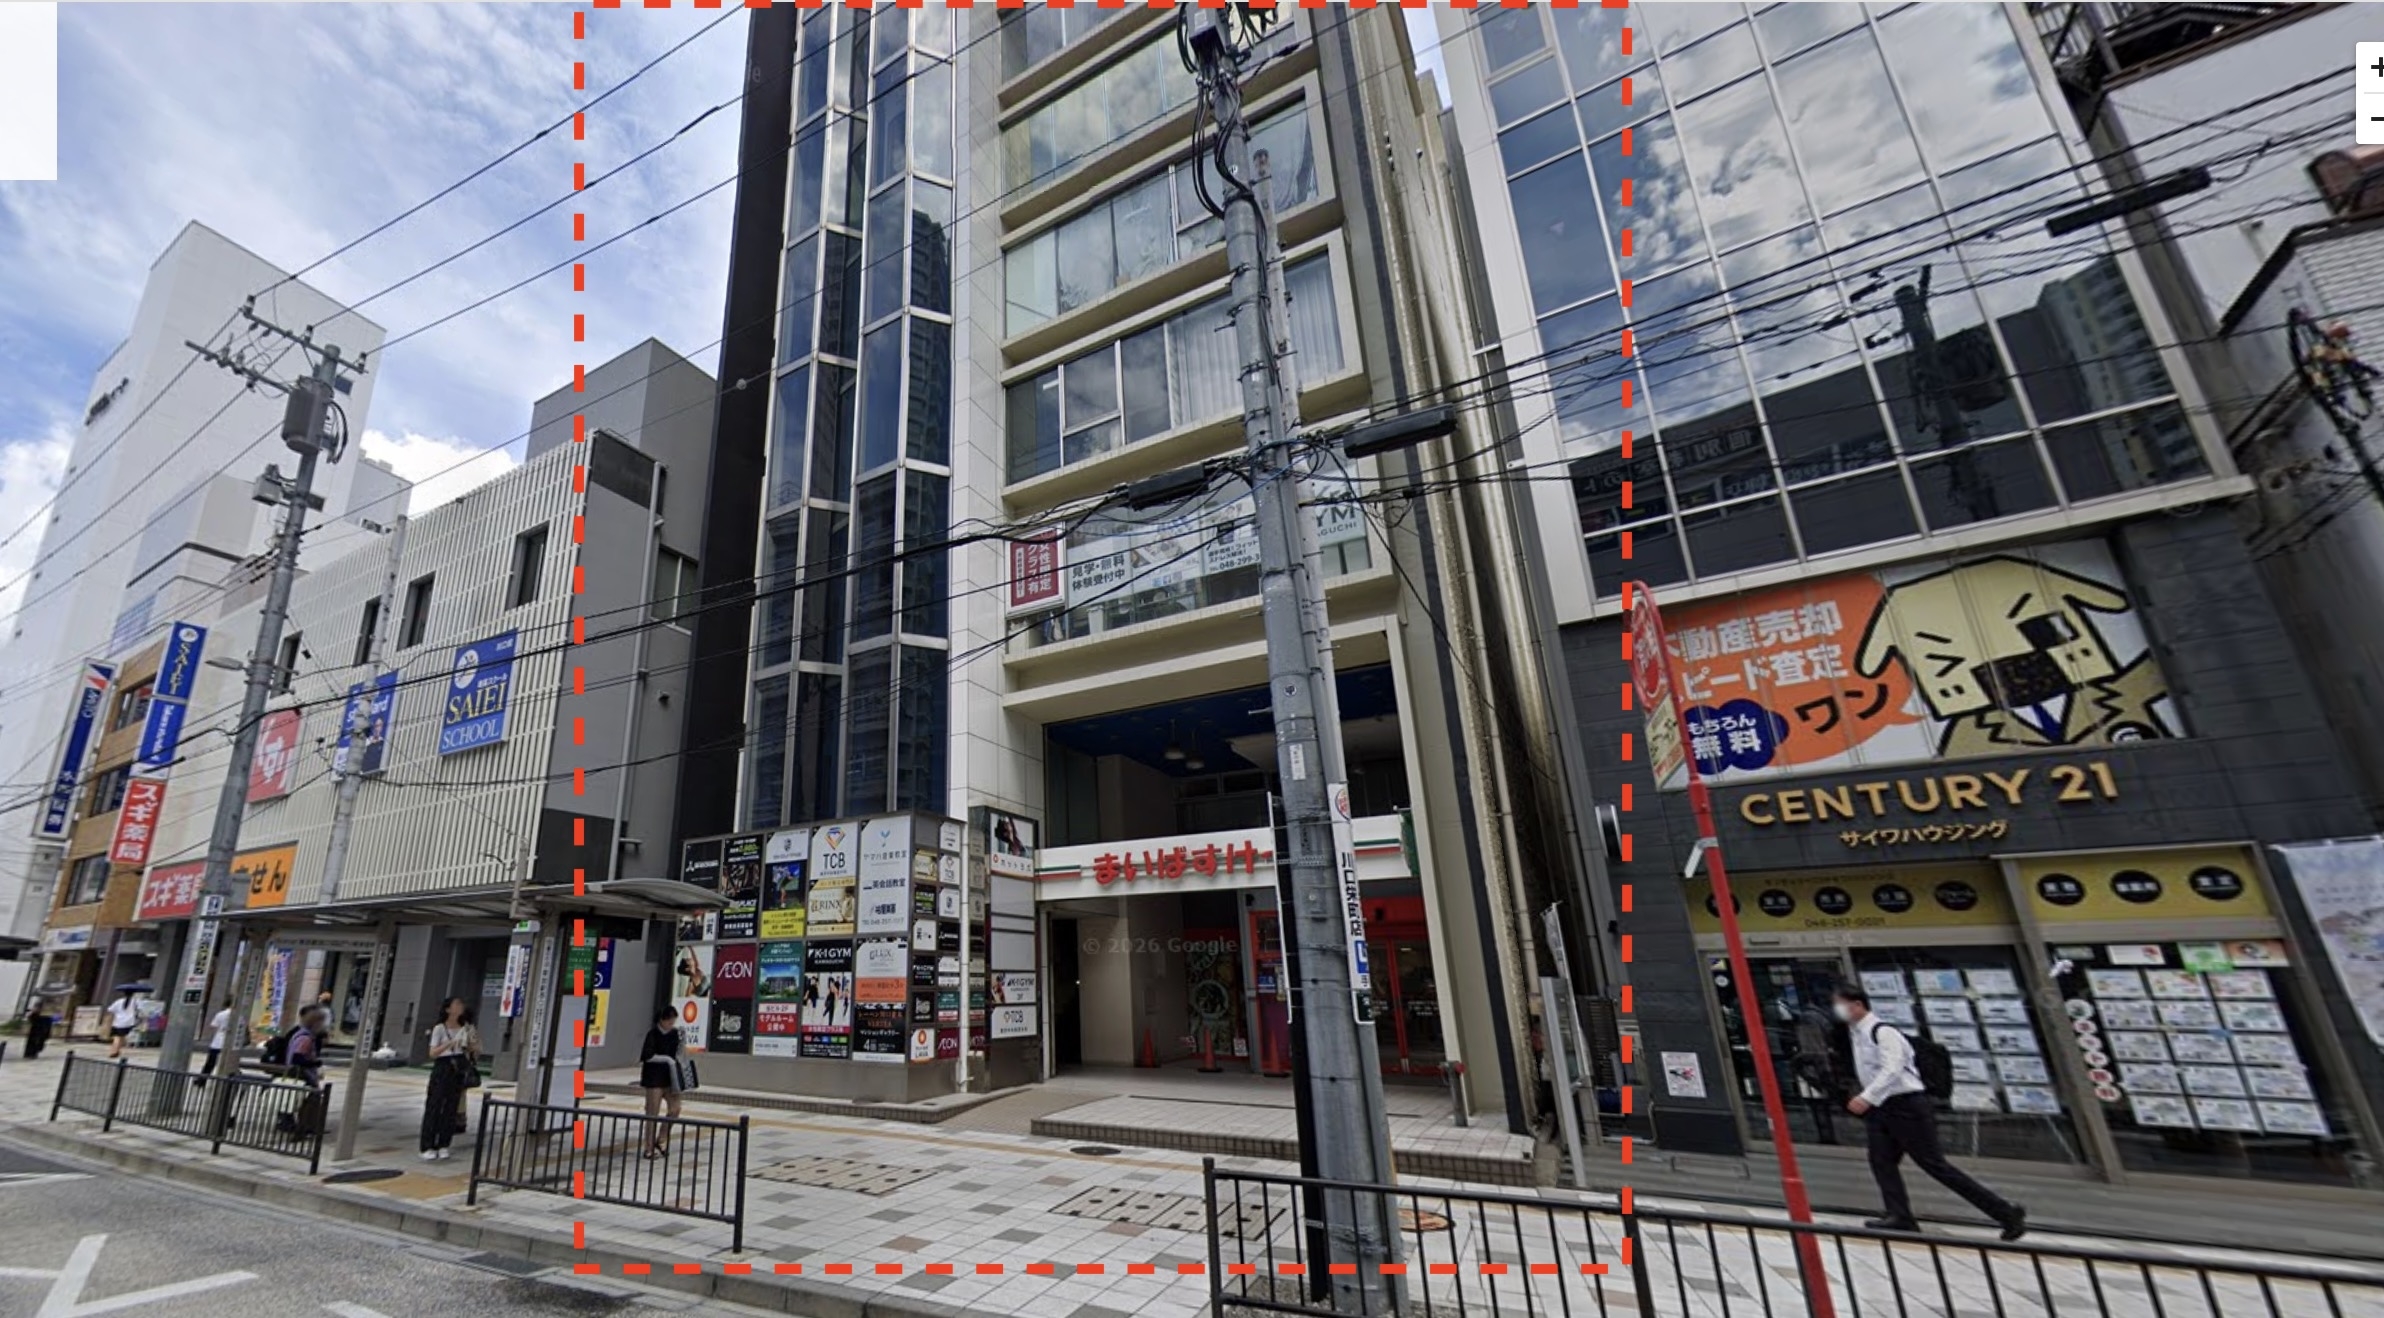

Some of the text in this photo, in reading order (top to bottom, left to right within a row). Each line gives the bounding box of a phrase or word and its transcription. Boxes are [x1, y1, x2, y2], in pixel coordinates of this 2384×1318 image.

[1316, 506, 1355, 527] YM
[1319, 522, 1357, 537] GUCHI
[1679, 644, 1849, 703] ピード査定
[446, 682, 507, 725] SAIEI
[1795, 684, 1888, 734] ワン
[441, 717, 500, 750] SCHOOL
[1687, 713, 1756, 736] もちろん
[1690, 728, 1762, 760] 無料
[1739, 762, 2121, 827] CENTURY 21
[116, 783, 158, 861] スギ薬局
[1838, 819, 2011, 848] サイワハウジング
[823, 852, 846, 869] TCB
